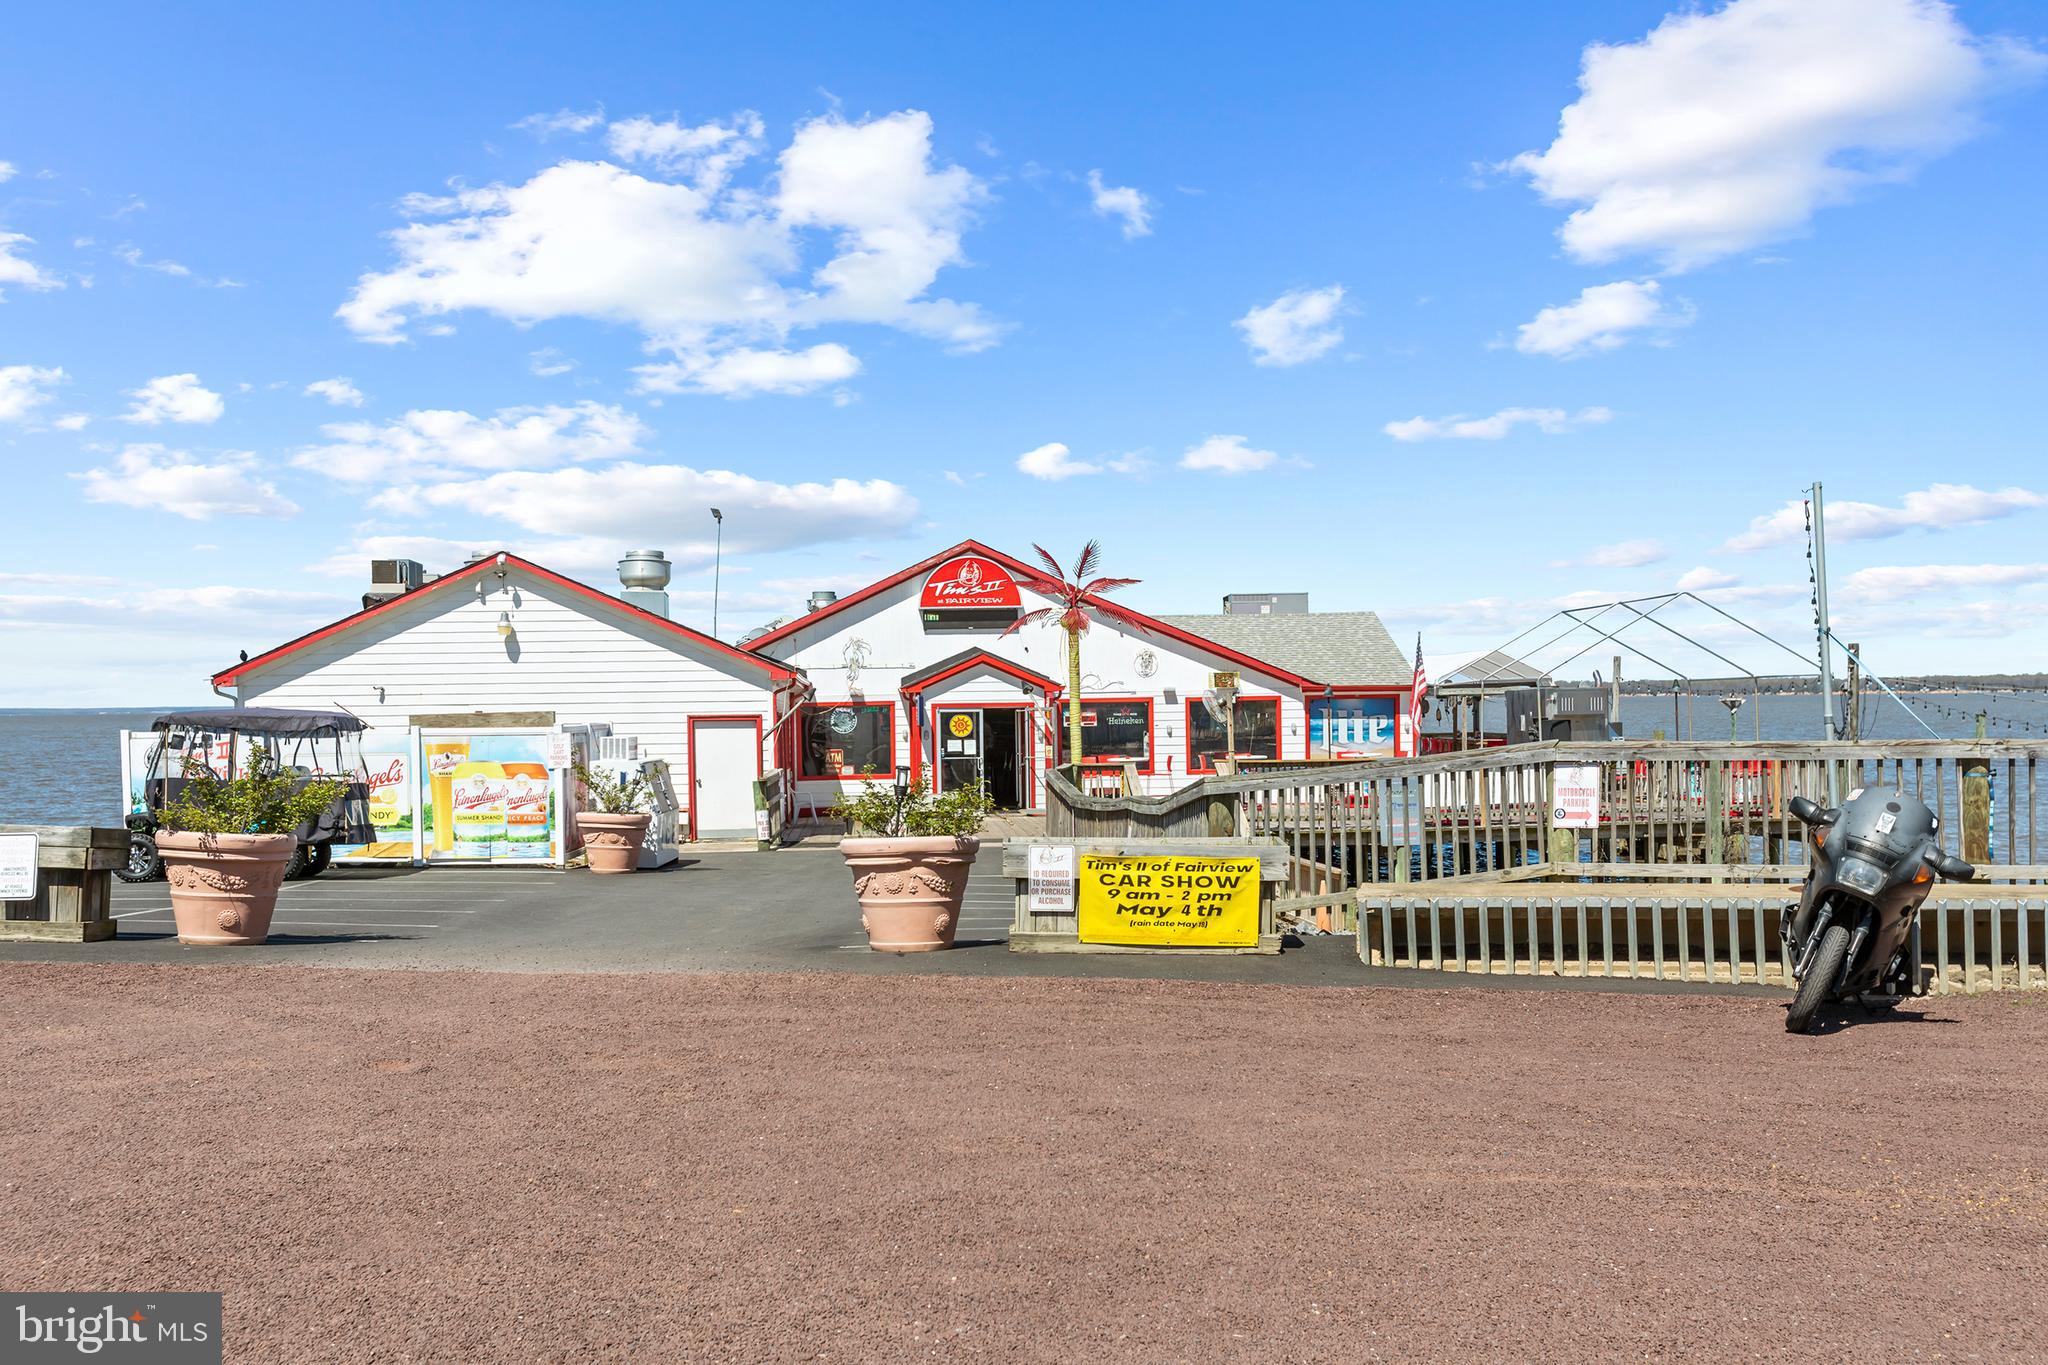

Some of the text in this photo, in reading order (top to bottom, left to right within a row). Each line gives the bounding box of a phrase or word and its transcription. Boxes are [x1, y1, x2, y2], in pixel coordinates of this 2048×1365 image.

[1108, 716, 1145, 725] Heineken
[1318, 708, 1388, 753] Lite
[825, 753, 842, 762] ATM
[1558, 788, 1596, 797] MOTORCYCLE
[1562, 798, 1590, 807] PARKING
[1086, 860, 1254, 873] Tim's II of Fairview
[1033, 870, 1070, 878] ID REQUIRED
[1100, 874, 1241, 888] CAR SHOW
[1041, 888, 1071, 896] PURCHASE
[1108, 888, 1121, 899] 9
[1126, 890, 1160, 900] am
[1182, 890, 1190, 900] 2
[1197, 892, 1232, 903] pm
[1116, 904, 1222, 918] May 4 th
[1130, 920, 1152, 928] (rain
